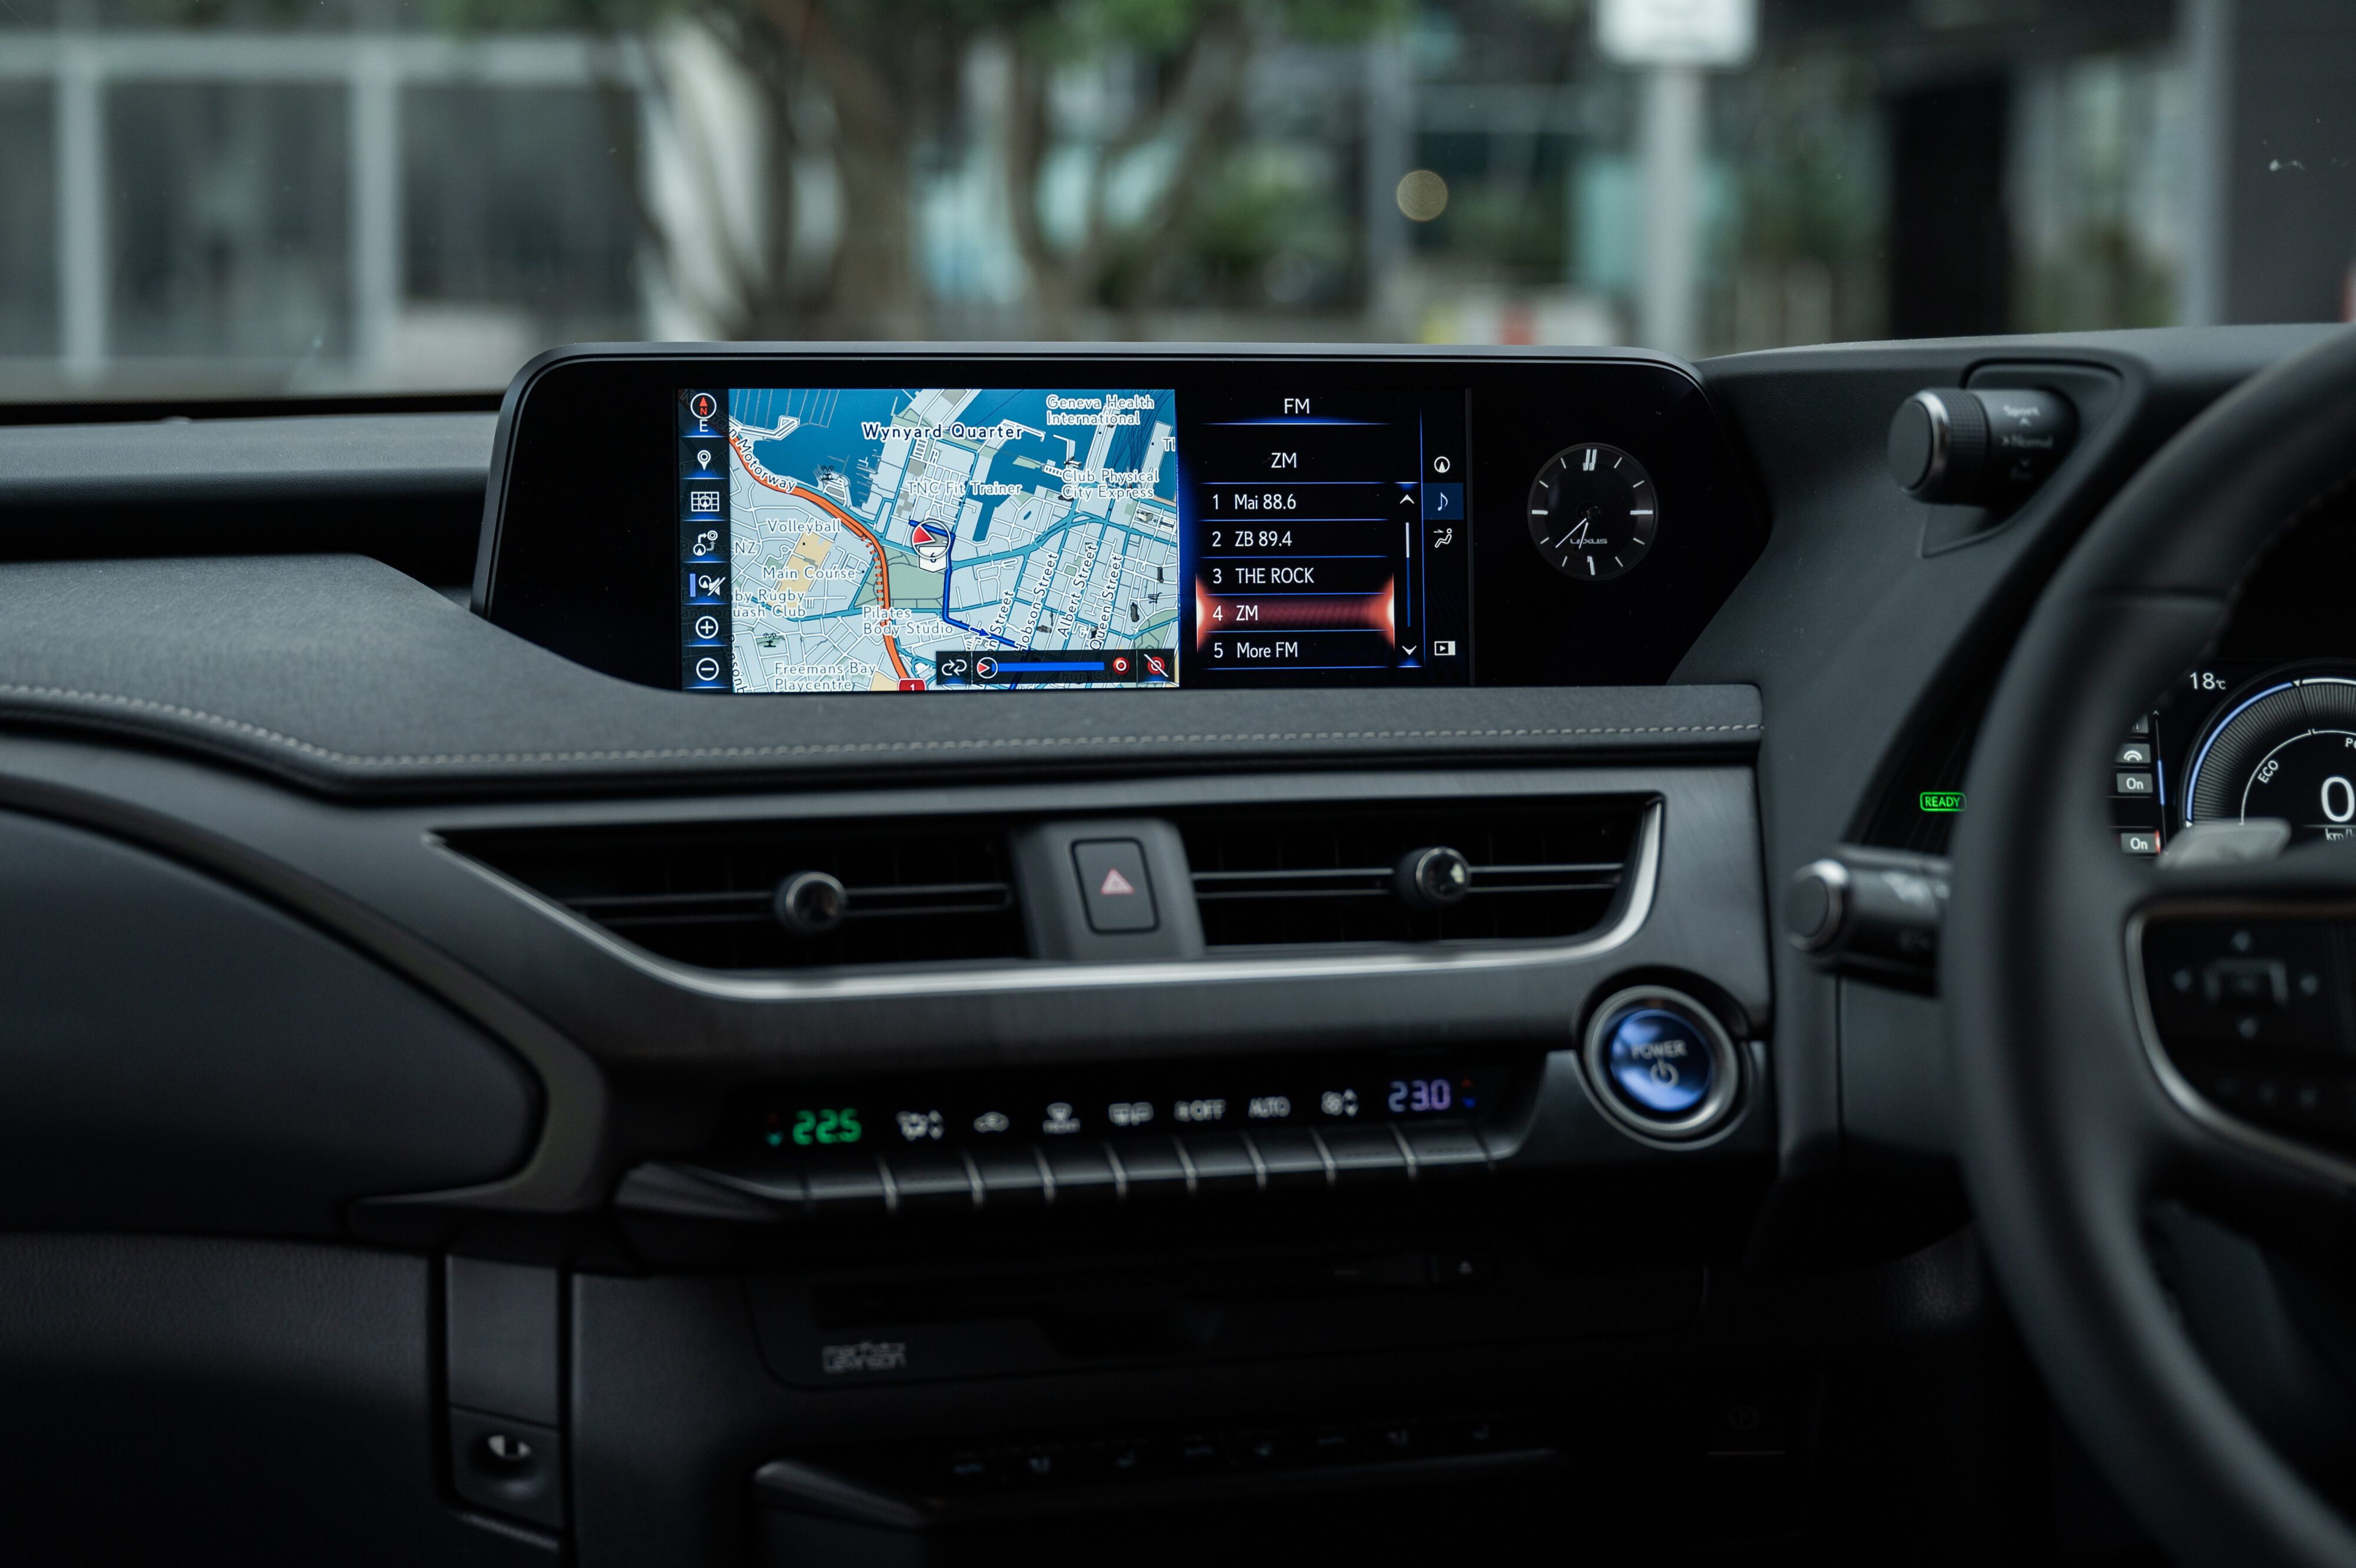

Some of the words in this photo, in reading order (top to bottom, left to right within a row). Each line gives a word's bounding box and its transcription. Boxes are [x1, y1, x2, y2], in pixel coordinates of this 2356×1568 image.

[1047, 395, 1100, 409] Geneva
[1107, 395, 1154, 409] Health
[1284, 398, 1310, 414] FM
[700, 407, 707, 415] N
[1047, 412, 1140, 425] International
[699, 419, 709, 432] E
[863, 423, 942, 439] Wynyard
[951, 423, 1023, 439] Quarter
[737, 439, 795, 491] Motorway
[1270, 452, 1297, 468] ZM
[1061, 469, 1095, 482] Club
[1101, 469, 1159, 484] Physical
[908, 481, 939, 494] TNC
[946, 482, 965, 494] Fit
[972, 482, 1022, 494] Trainer
[1061, 486, 1092, 499] City
[1098, 486, 1154, 499] Express
[1212, 494, 1219, 510] 1
[1235, 494, 1259, 510] Mai
[1263, 494, 1296, 510] 88.6
[767, 519, 841, 534] Volleyball
[1212, 531, 1222, 547] 2
[1235, 531, 1254, 547] ZB
[1258, 531, 1293, 547] 89.4
[734, 542, 756, 554] NZ
[763, 567, 798, 580] Main
[803, 567, 856, 580] Course
[1213, 568, 1222, 584] 3
[1235, 568, 1266, 584] THE
[1271, 567, 1315, 583] ROCK
[759, 589, 805, 603] Rugby
[1057, 593, 1081, 638] Albert
[1074, 545, 1097, 588] Street
[1017, 601, 1041, 654] Hobson
[1034, 553, 1058, 596] Street
[1090, 606, 1112, 650] Queen
[1102, 555, 1122, 600] Street
[772, 604, 806, 617] Club
[863, 606, 911, 618] Pilates
[990, 590, 1014, 634] Street
[1212, 605, 1223, 621] 4
[1236, 605, 1259, 621] ZM
[864, 622, 901, 636] Body
[906, 621, 953, 634] Studio
[1214, 643, 1223, 659] 5
[1237, 642, 1271, 658] More
[1276, 641, 1298, 657] FM
[775, 663, 845, 674] Freemans
[850, 662, 876, 675] Bay
[775, 678, 852, 692] Playcentre
[2257, 760, 2279, 784] ECO
[2126, 778, 2144, 790] On
[1924, 796, 1961, 808] READY
[2321, 776, 2355, 822] 0
[2130, 838, 2148, 851] On
[1630, 1040, 1688, 1059] POWER
